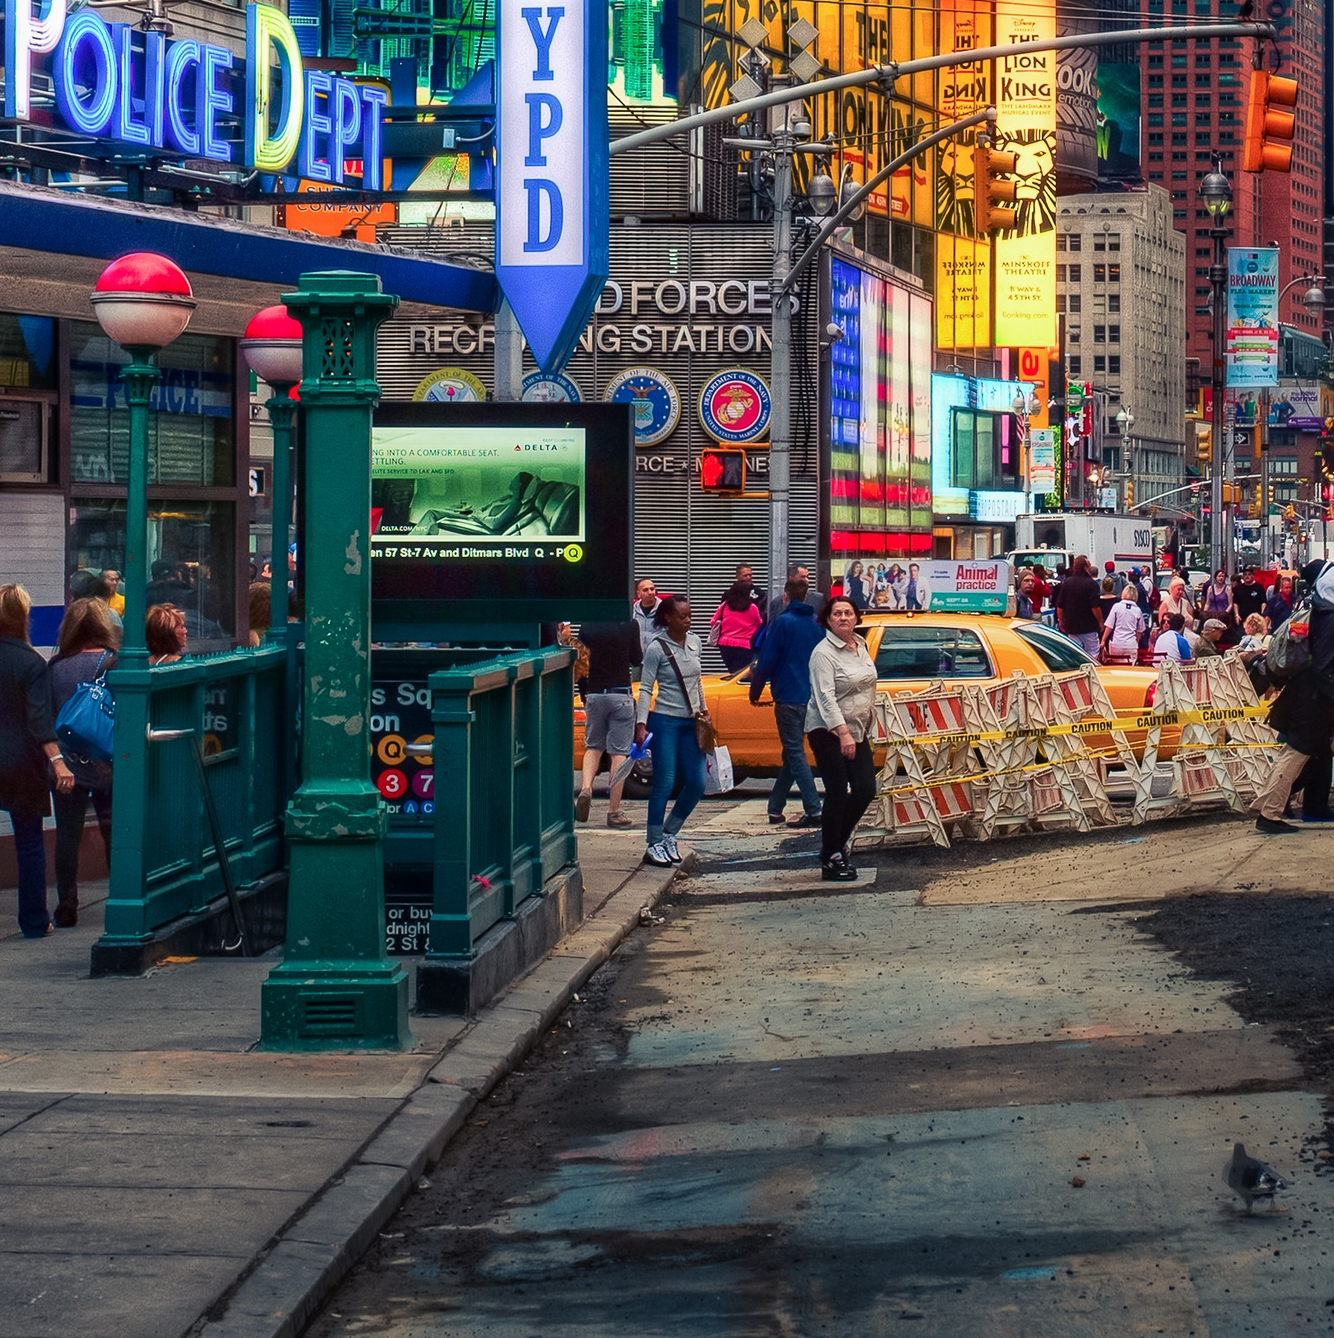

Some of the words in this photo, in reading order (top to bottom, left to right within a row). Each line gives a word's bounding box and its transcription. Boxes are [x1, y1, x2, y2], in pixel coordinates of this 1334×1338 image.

[856, 10, 888, 65] THE
[1001, 77, 1051, 102] KING
[1230, 274, 1276, 287] BROADWAY
[704, 372, 738, 406] DEPARTMENT
[757, 384, 769, 404] NAVY
[386, 449, 407, 457] INTO
[409, 449, 415, 457] A
[416, 449, 476, 457] COMFORTABLE
[478, 449, 499, 457] SEAT.
[385, 548, 398, 557] 57
[400, 548, 421, 557] St-7
[423, 548, 437, 557] Av
[439, 548, 458, 557] and
[459, 548, 502, 557] Ditmars
[505, 548, 529, 557] Blvd
[534, 548, 544, 558] Q
[956, 564, 998, 580] Animal
[956, 580, 996, 591] practice
[397, 683, 433, 710] Sq
[1136, 714, 1178, 728] CAUTION
[1202, 708, 1245, 722] CAUTION
[1005, 728, 1047, 739] CAUTION
[1071, 721, 1113, 733] CAUTION
[384, 740, 401, 759] Q
[385, 774, 399, 793] 3
[420, 774, 434, 793] 7
[401, 937, 418, 951] St
